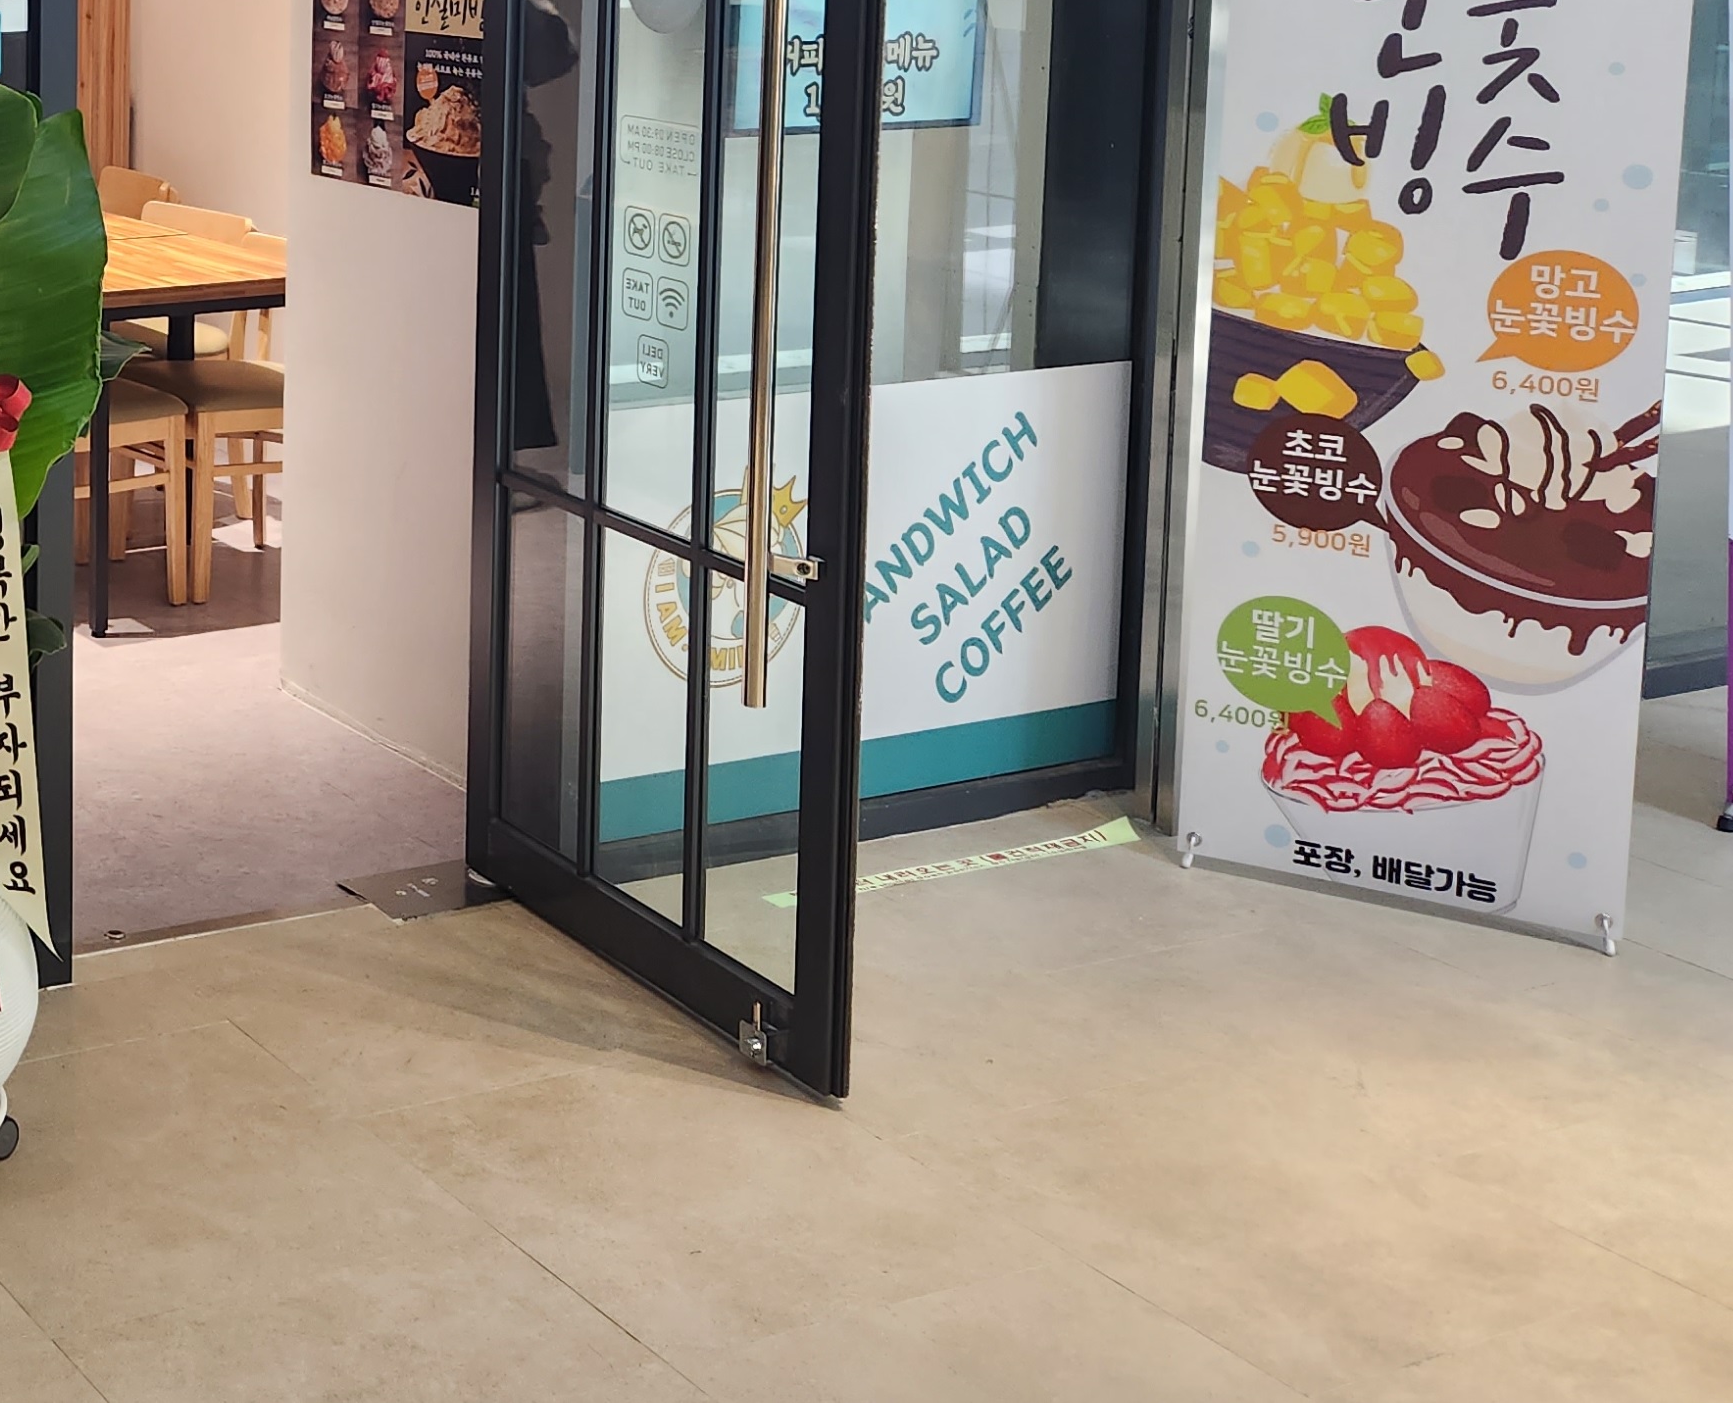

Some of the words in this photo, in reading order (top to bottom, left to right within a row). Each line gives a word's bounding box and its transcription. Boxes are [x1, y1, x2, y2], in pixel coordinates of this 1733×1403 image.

[1530, 263, 1602, 300] 망고
[1489, 300, 1637, 344] 눈꽃빙수
[1491, 369, 1600, 403] 6,400원
[1281, 428, 1348, 465] 초코
[1248, 460, 1379, 505] 눈꽃빙수
[865, 411, 1037, 625] ANDWICH
[1271, 523, 1371, 559] 5,900원
[910, 506, 1032, 646] SALAD
[656, 601, 688, 647] AM
[934, 544, 1073, 704] COFFEE
[1251, 607, 1315, 649] 딸기
[1216, 641, 1349, 689] 눈꽃빙수
[1194, 698, 1290, 734] 6,400원
[1292, 838, 1363, 880] 포장,
[1371, 855, 1498, 904] 배달가능
